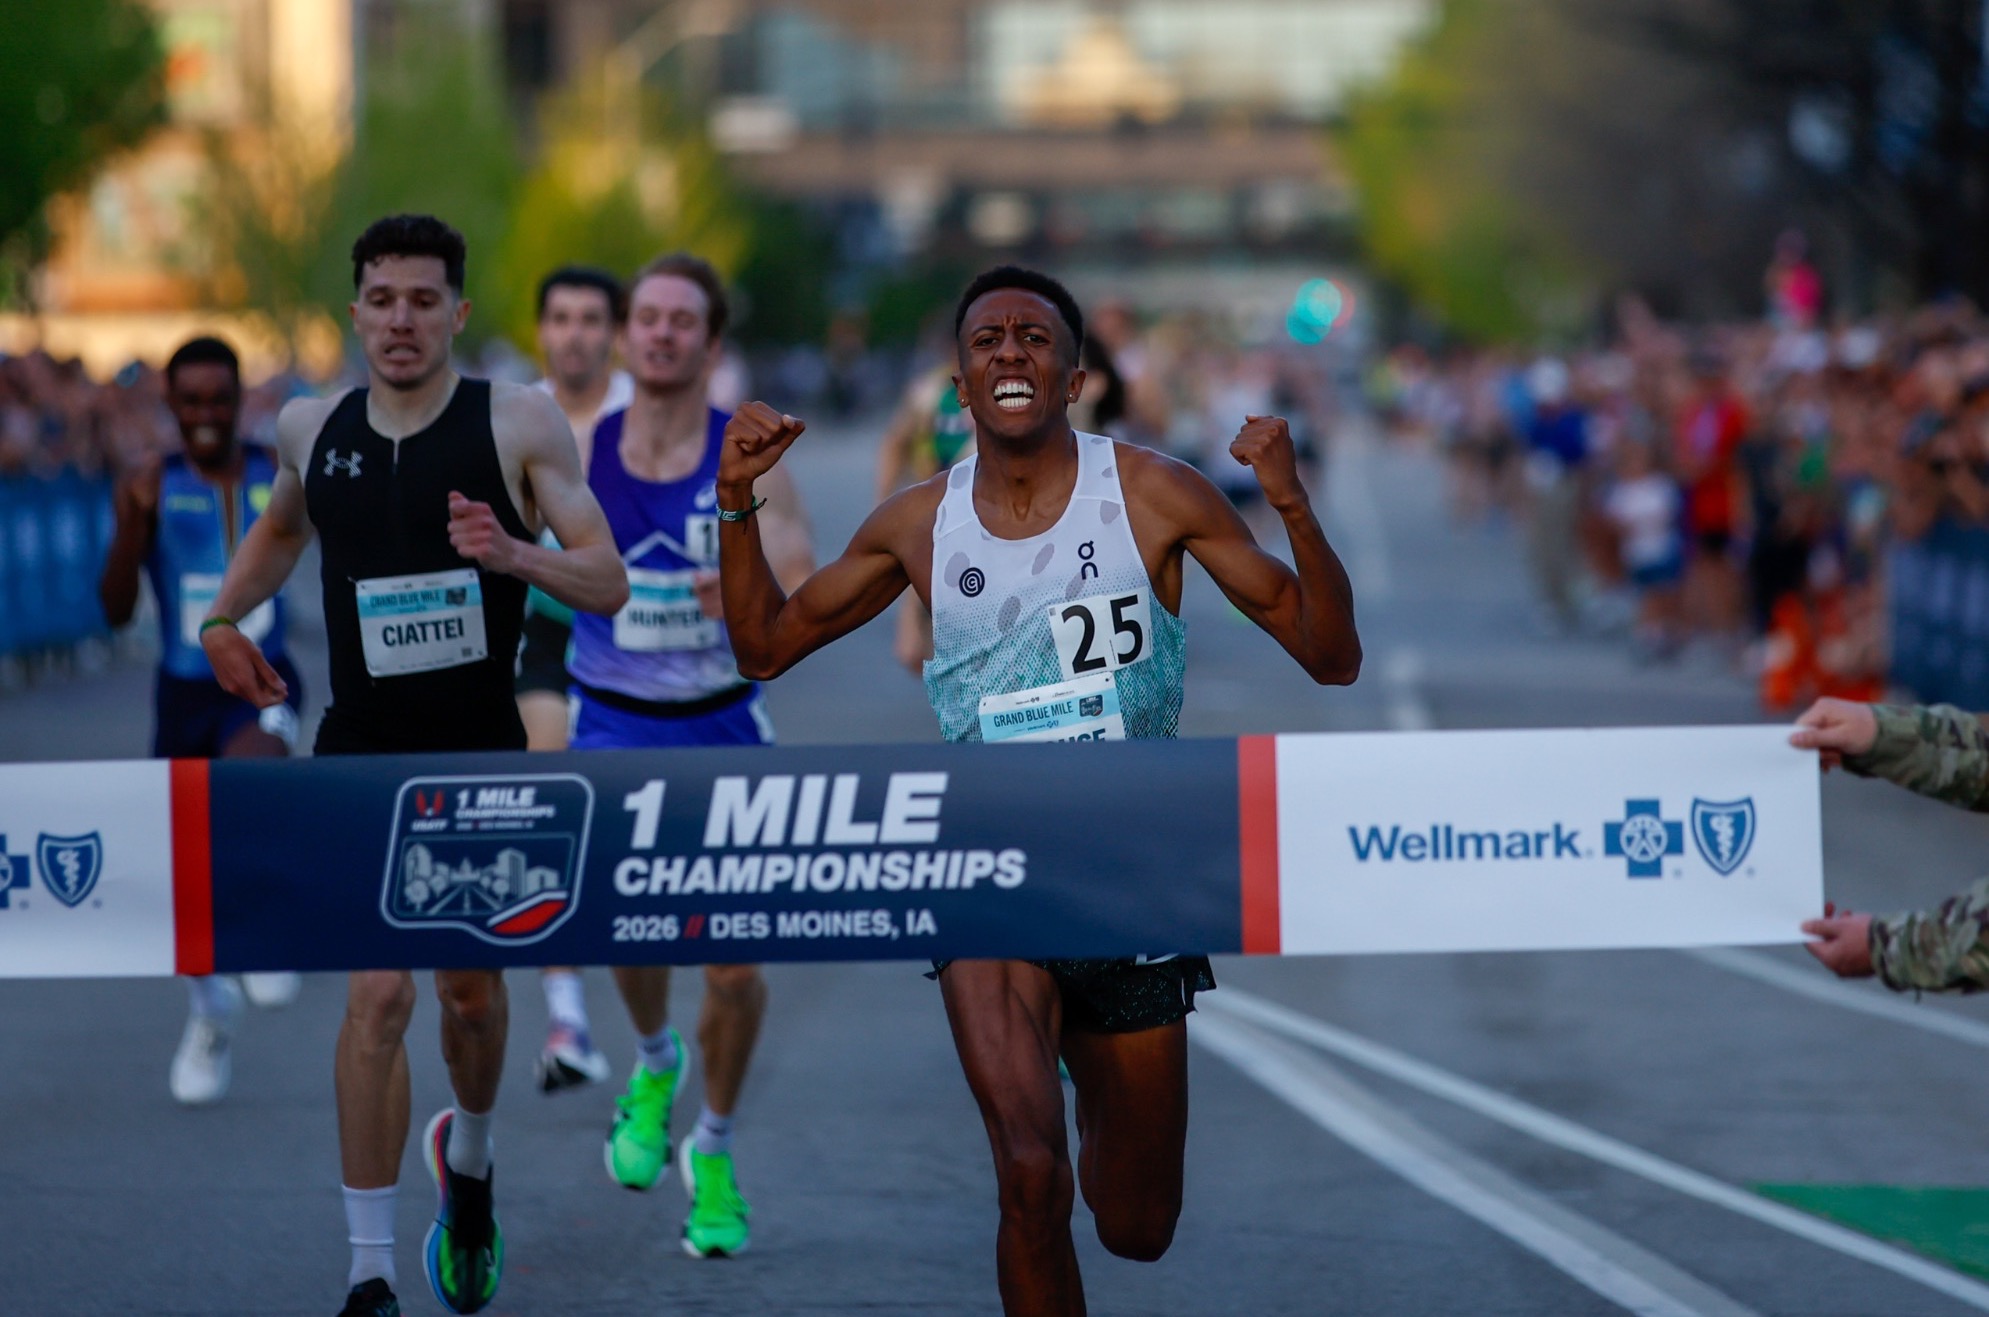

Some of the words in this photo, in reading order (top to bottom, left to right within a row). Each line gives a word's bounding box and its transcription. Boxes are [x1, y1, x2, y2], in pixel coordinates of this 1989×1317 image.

[382, 617, 464, 648] CIATTEI
[1061, 594, 1143, 674] 25
[993, 711, 1025, 728] GRAND
[1026, 705, 1050, 722] BLUE
[1051, 701, 1074, 717] MILE
[455, 804, 556, 819] CHAMPIONSHIPS
[457, 788, 469, 808] 1
[477, 786, 537, 808] MILE
[623, 779, 666, 849] 1
[703, 772, 949, 848] MILE
[613, 849, 1027, 896] CHAMPIONSHIPS
[612, 914, 680, 941] 2026
[709, 911, 771, 939] DES
[776, 908, 900, 941] MOINES,
[906, 908, 938, 937] IA
